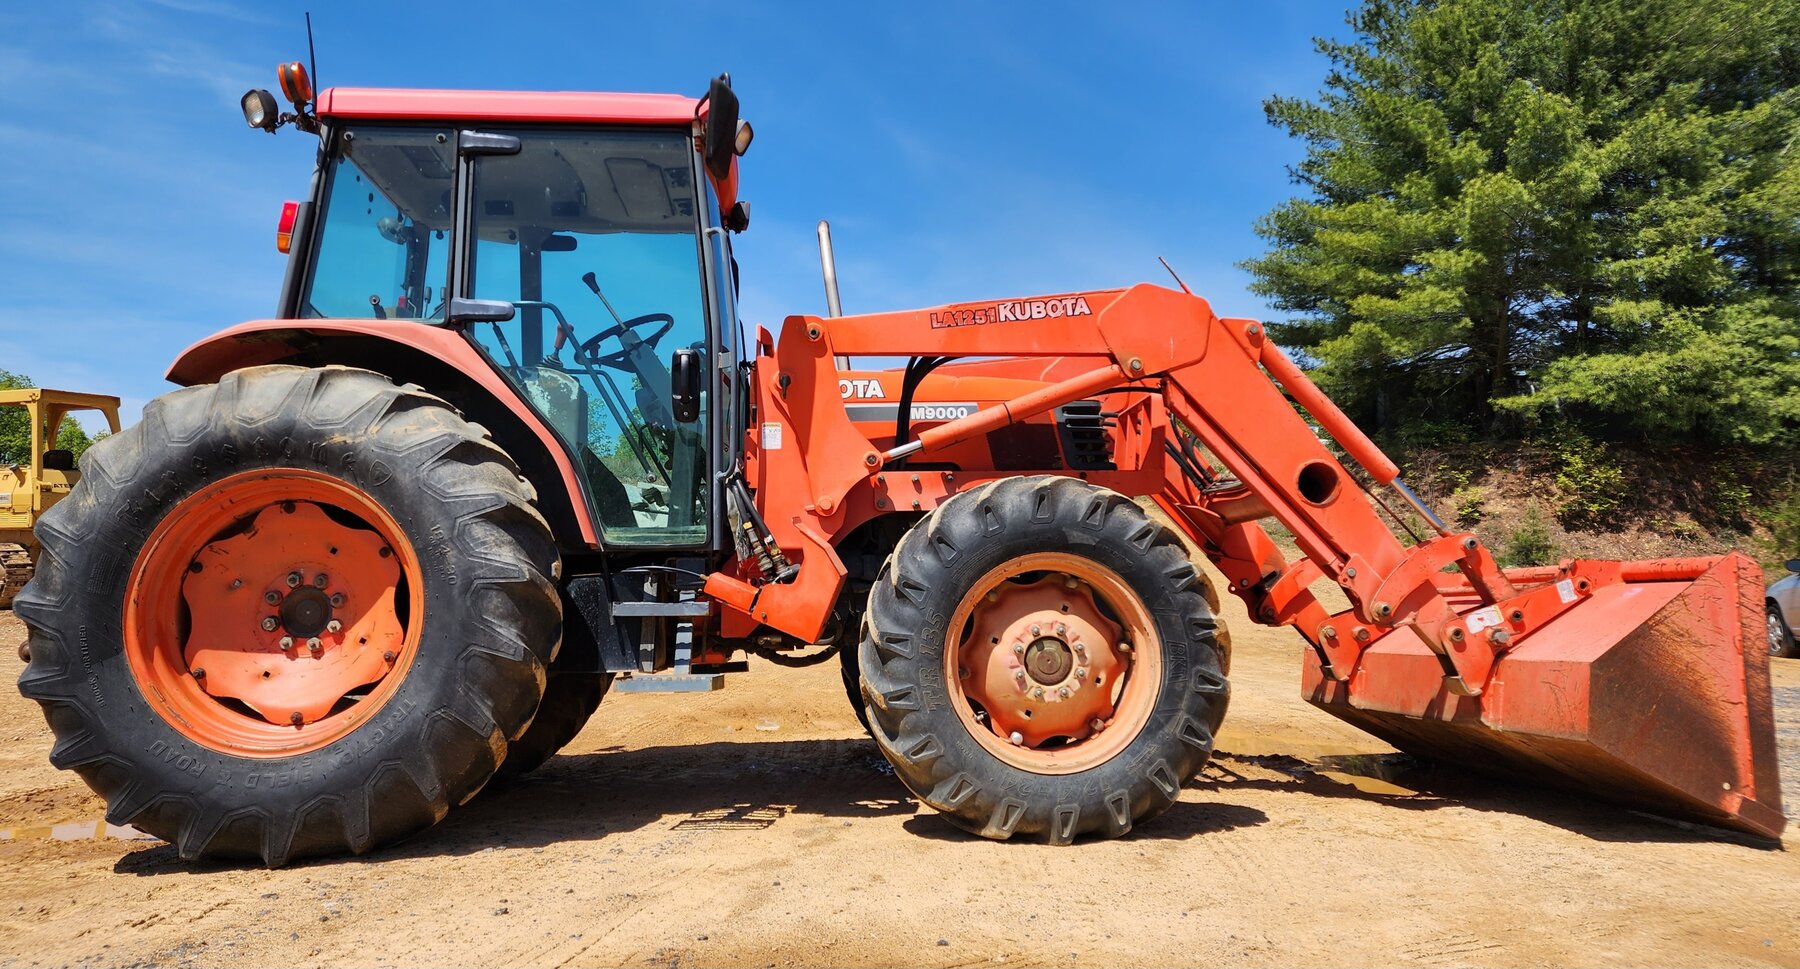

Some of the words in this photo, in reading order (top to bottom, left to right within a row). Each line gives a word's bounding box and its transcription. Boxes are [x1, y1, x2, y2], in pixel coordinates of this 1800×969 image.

[930, 307, 997, 329] LA1251
[998, 297, 1093, 323] KUBOTA
[910, 406, 968, 420] M9000
[919, 607, 945, 658] 135
[1166, 640, 1188, 684] BKT
[149, 739, 208, 779] ROAD
[246, 765, 313, 790] FIELD
